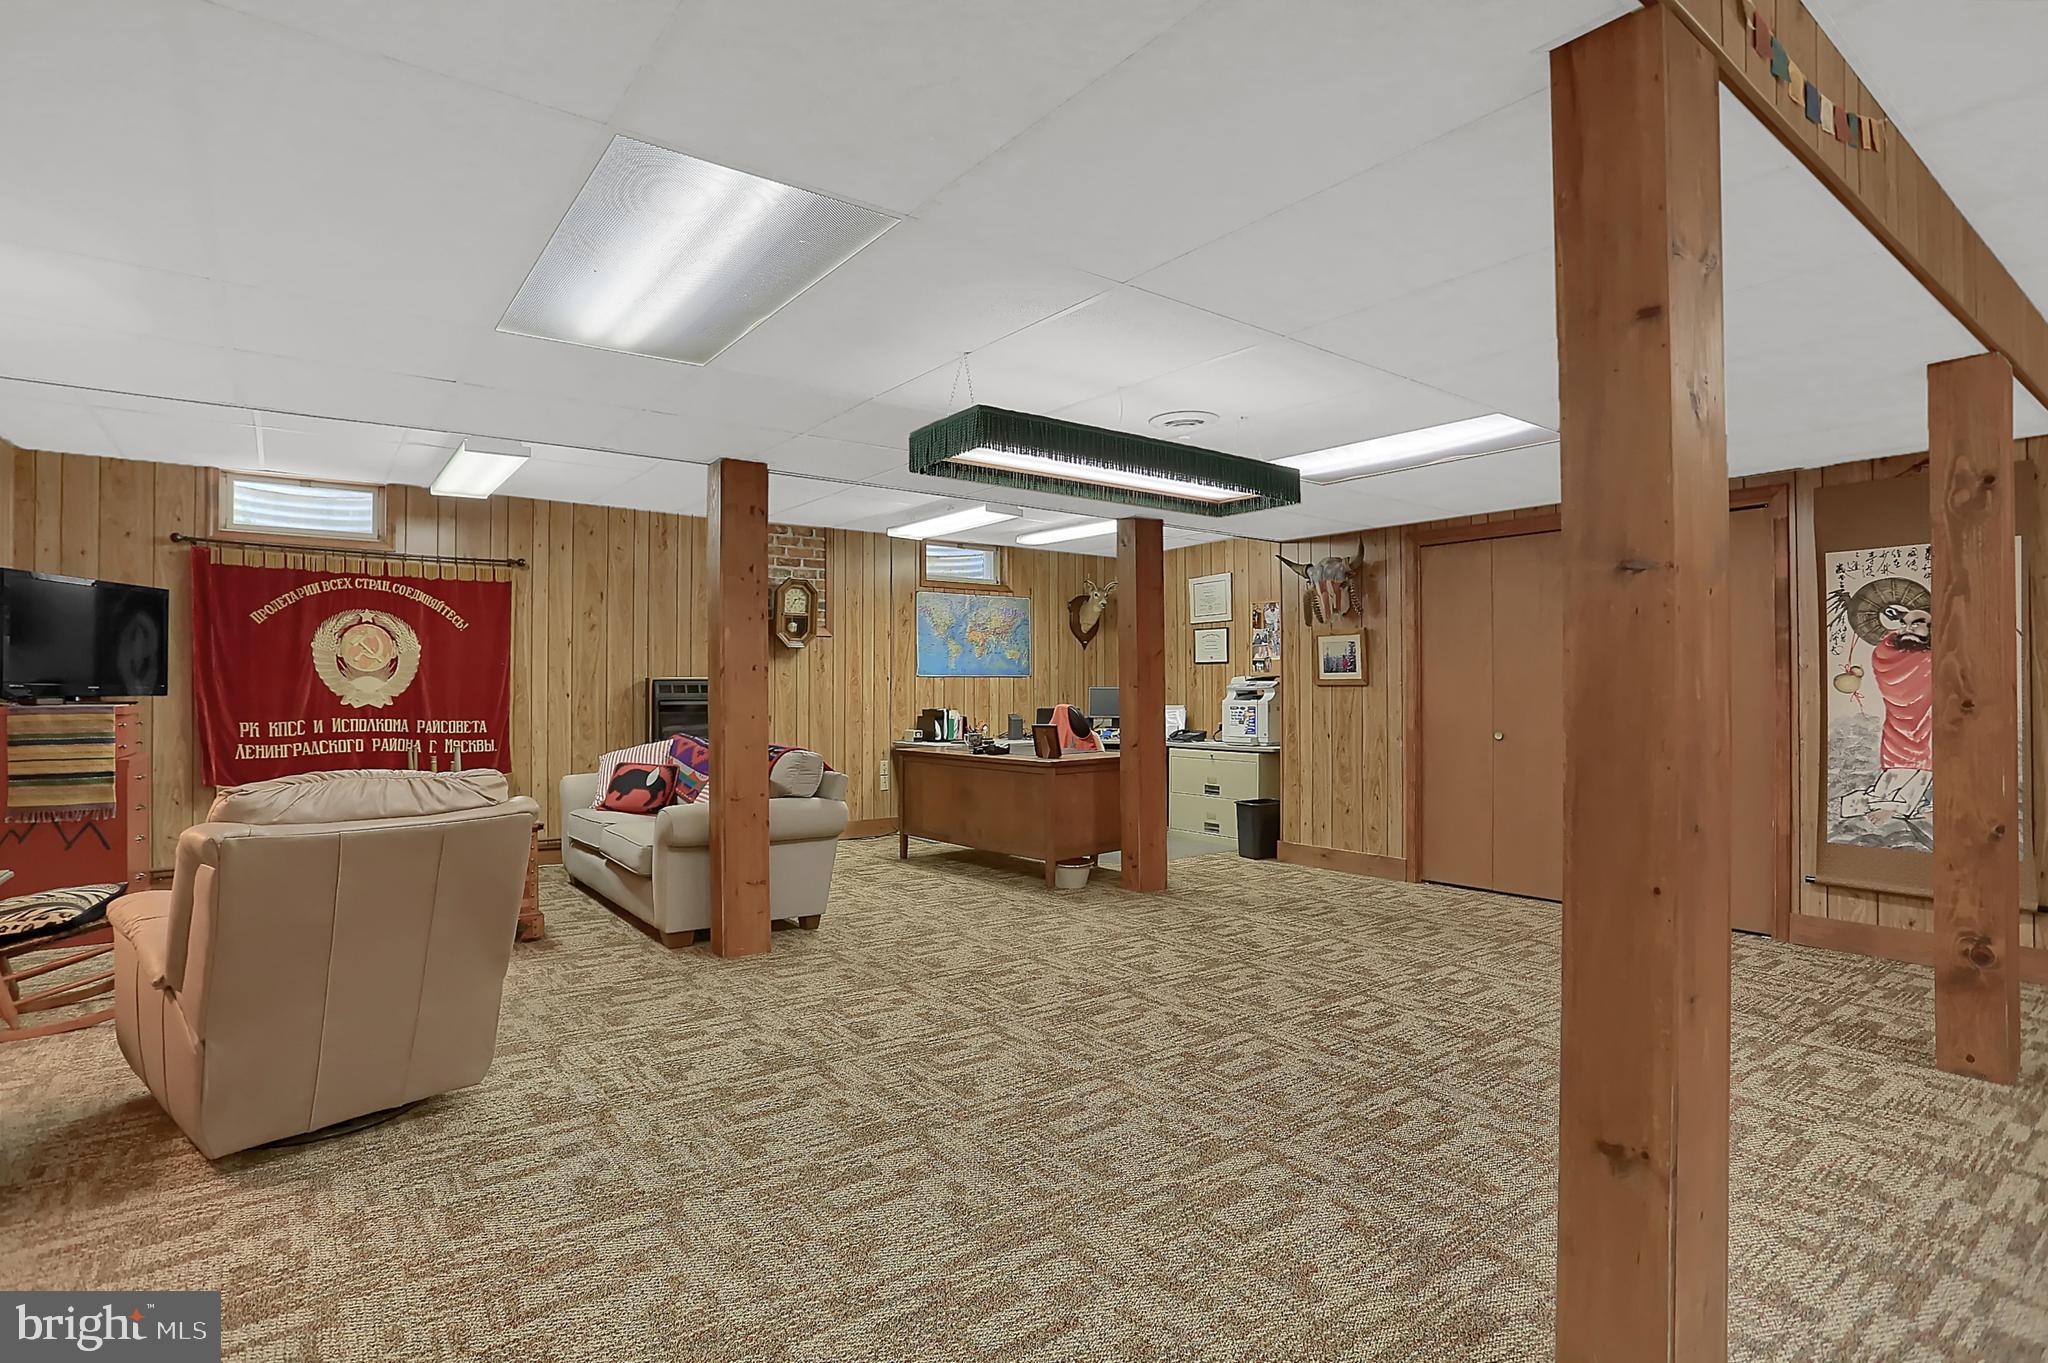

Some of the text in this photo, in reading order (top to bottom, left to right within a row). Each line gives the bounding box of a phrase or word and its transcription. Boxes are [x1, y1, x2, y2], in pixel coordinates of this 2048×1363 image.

[249, 582, 322, 625] ПРОЛЕТАРИИ
[321, 578, 353, 592] ВСЕХ
[392, 583, 469, 632] СОЕДИНЯЙТЕСЬ!
[239, 717, 488, 738] РК КПСС И ИСПОЛКОМА РАЙСОВЕТА
[234, 739, 365, 760] ЛЕНИНГРАДСКОГО
[371, 737, 422, 753] РАЙОНА
[428, 740, 438, 754] Г.
